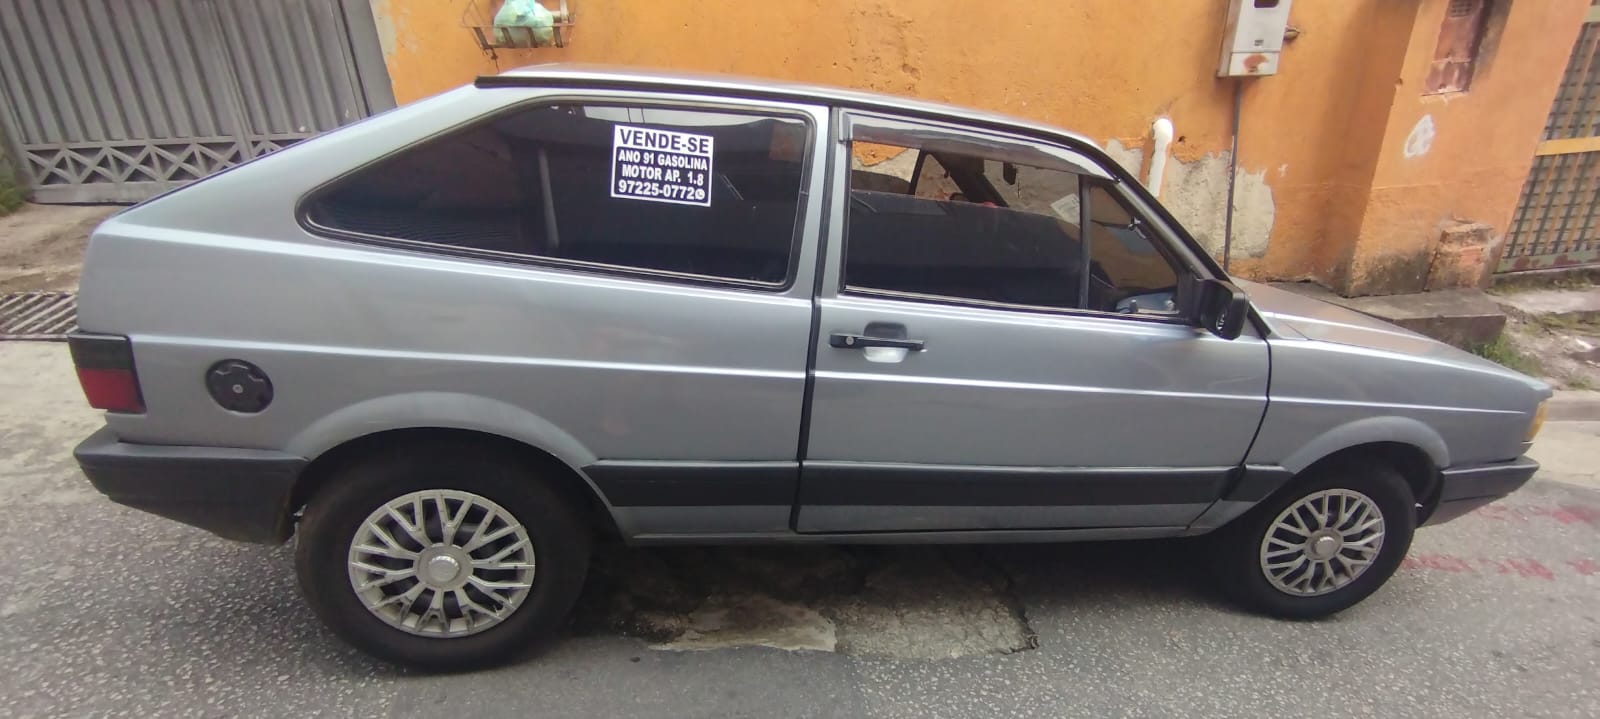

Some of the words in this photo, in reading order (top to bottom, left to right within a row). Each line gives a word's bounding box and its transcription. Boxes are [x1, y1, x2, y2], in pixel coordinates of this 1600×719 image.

[620, 129, 709, 154] VENDE-SE
[618, 150, 641, 163] ANO
[643, 152, 654, 165] 91
[657, 153, 708, 171] GASOLINA
[622, 164, 662, 180] MOTOR
[665, 169, 681, 183] AP.
[688, 171, 704, 186] 1.8
[618, 179, 695, 200] 97225-0772
